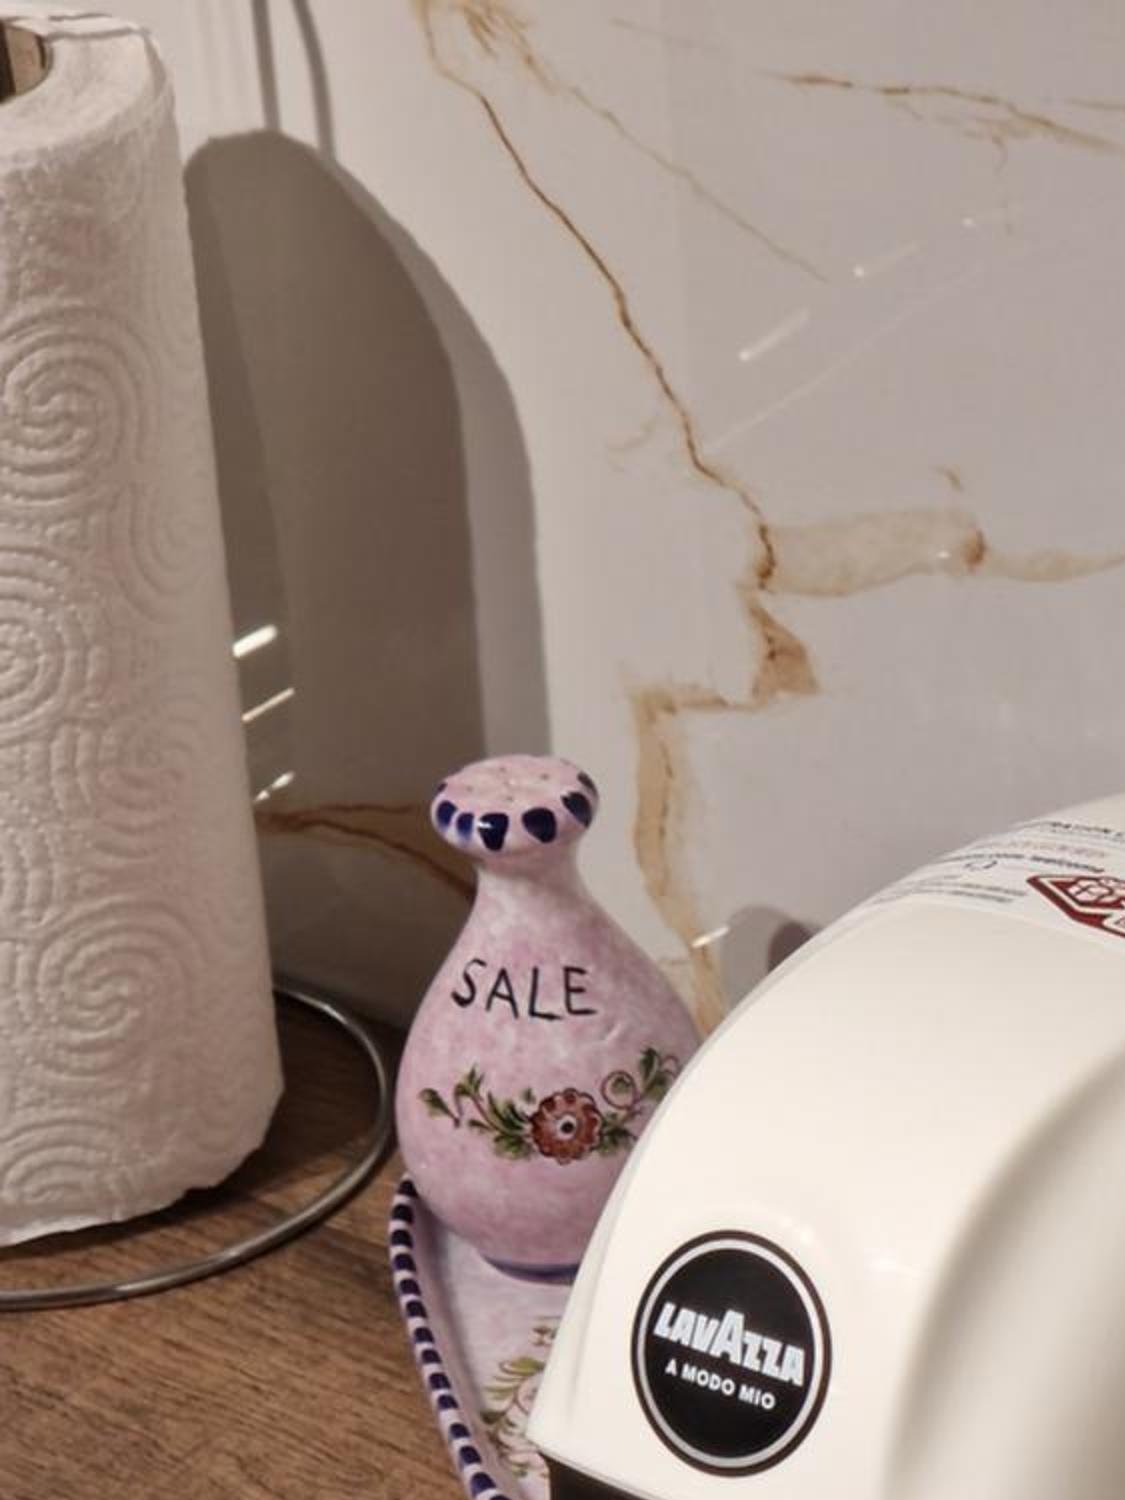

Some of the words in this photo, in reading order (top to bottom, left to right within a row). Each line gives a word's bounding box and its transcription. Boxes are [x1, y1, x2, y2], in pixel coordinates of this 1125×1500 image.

[451, 957, 598, 1021] SALE
[652, 1301, 805, 1387] LAVAZZA
[665, 1358, 678, 1377] A
[681, 1365, 737, 1397] MODO
[738, 1384, 776, 1411] MIO
